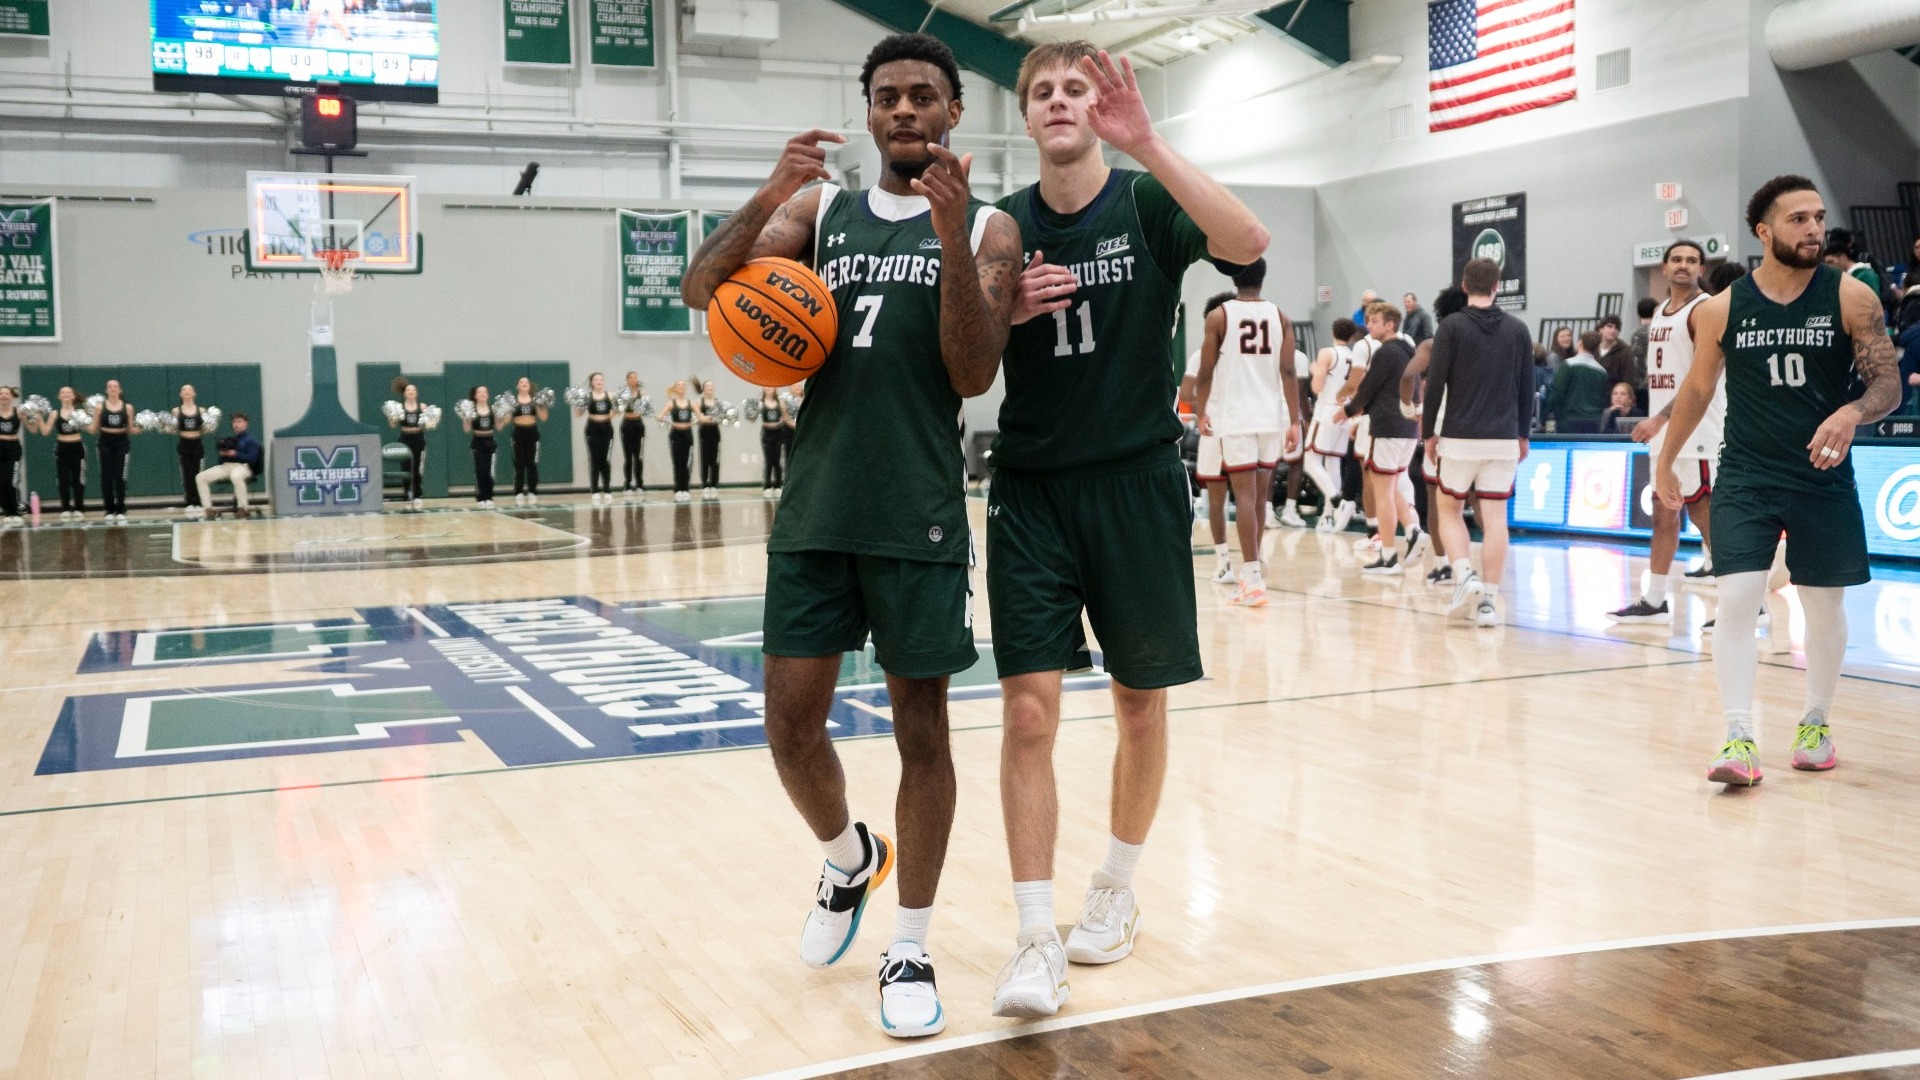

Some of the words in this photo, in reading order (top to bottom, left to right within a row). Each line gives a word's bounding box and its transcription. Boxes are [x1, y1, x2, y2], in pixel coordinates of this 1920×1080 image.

[510, 2, 563, 15] CHAMPIONS
[597, 3, 621, 13] DUAL
[622, 4, 646, 15] MEET
[539, 17, 560, 28] GOLF
[596, 13, 647, 25] CHAMPIONS
[600, 26, 645, 36] WRESTLING
[1662, 184, 1677, 199] EXIT
[1668, 210, 1683, 226] EXIT
[630, 231, 677, 241] MERCYHURST
[1095, 233, 1129, 256] NEC
[10, 254, 46, 271] VAIL
[624, 254, 685, 266] CONFERENCE
[627, 265, 682, 277] CHAMPIONS
[6, 290, 48, 301] ROWING
[627, 286, 682, 296] BASKETBALL
[766, 271, 824, 318] NCAA
[734, 292, 810, 362] Wilson
[852, 294, 884, 348] 7
[1052, 299, 1097, 357] 11
[1238, 319, 1272, 355] 21
[1649, 326, 1674, 342] SAINT
[1736, 328, 1835, 349] MERCYHURST
[1655, 346, 1664, 369] 8
[1767, 352, 1807, 387] 10
[288, 467, 368, 480] MERCYHURST
